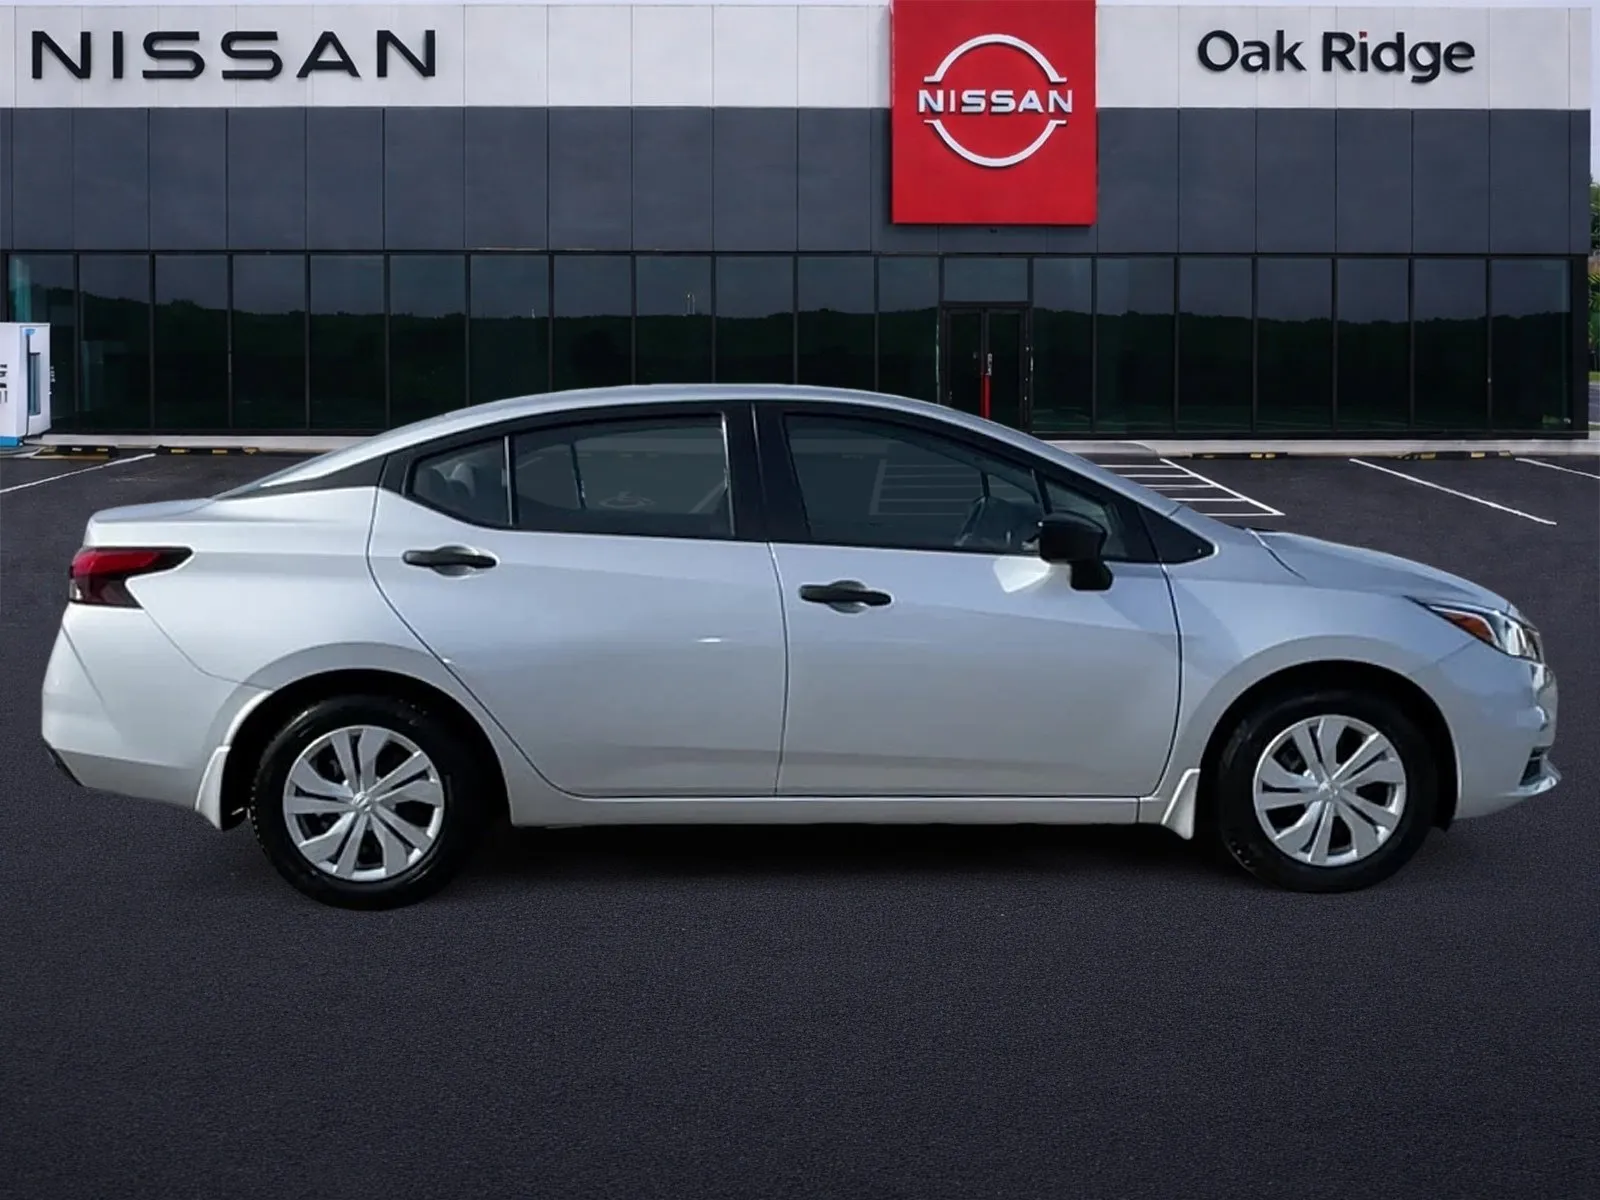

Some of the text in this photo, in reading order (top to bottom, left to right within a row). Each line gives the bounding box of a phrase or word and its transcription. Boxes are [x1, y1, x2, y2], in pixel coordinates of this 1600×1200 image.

[32, 30, 435, 80] NISSAN
[1198, 30, 1475, 84] Oak Ridge
[918, 89, 1073, 114] NISSAN
